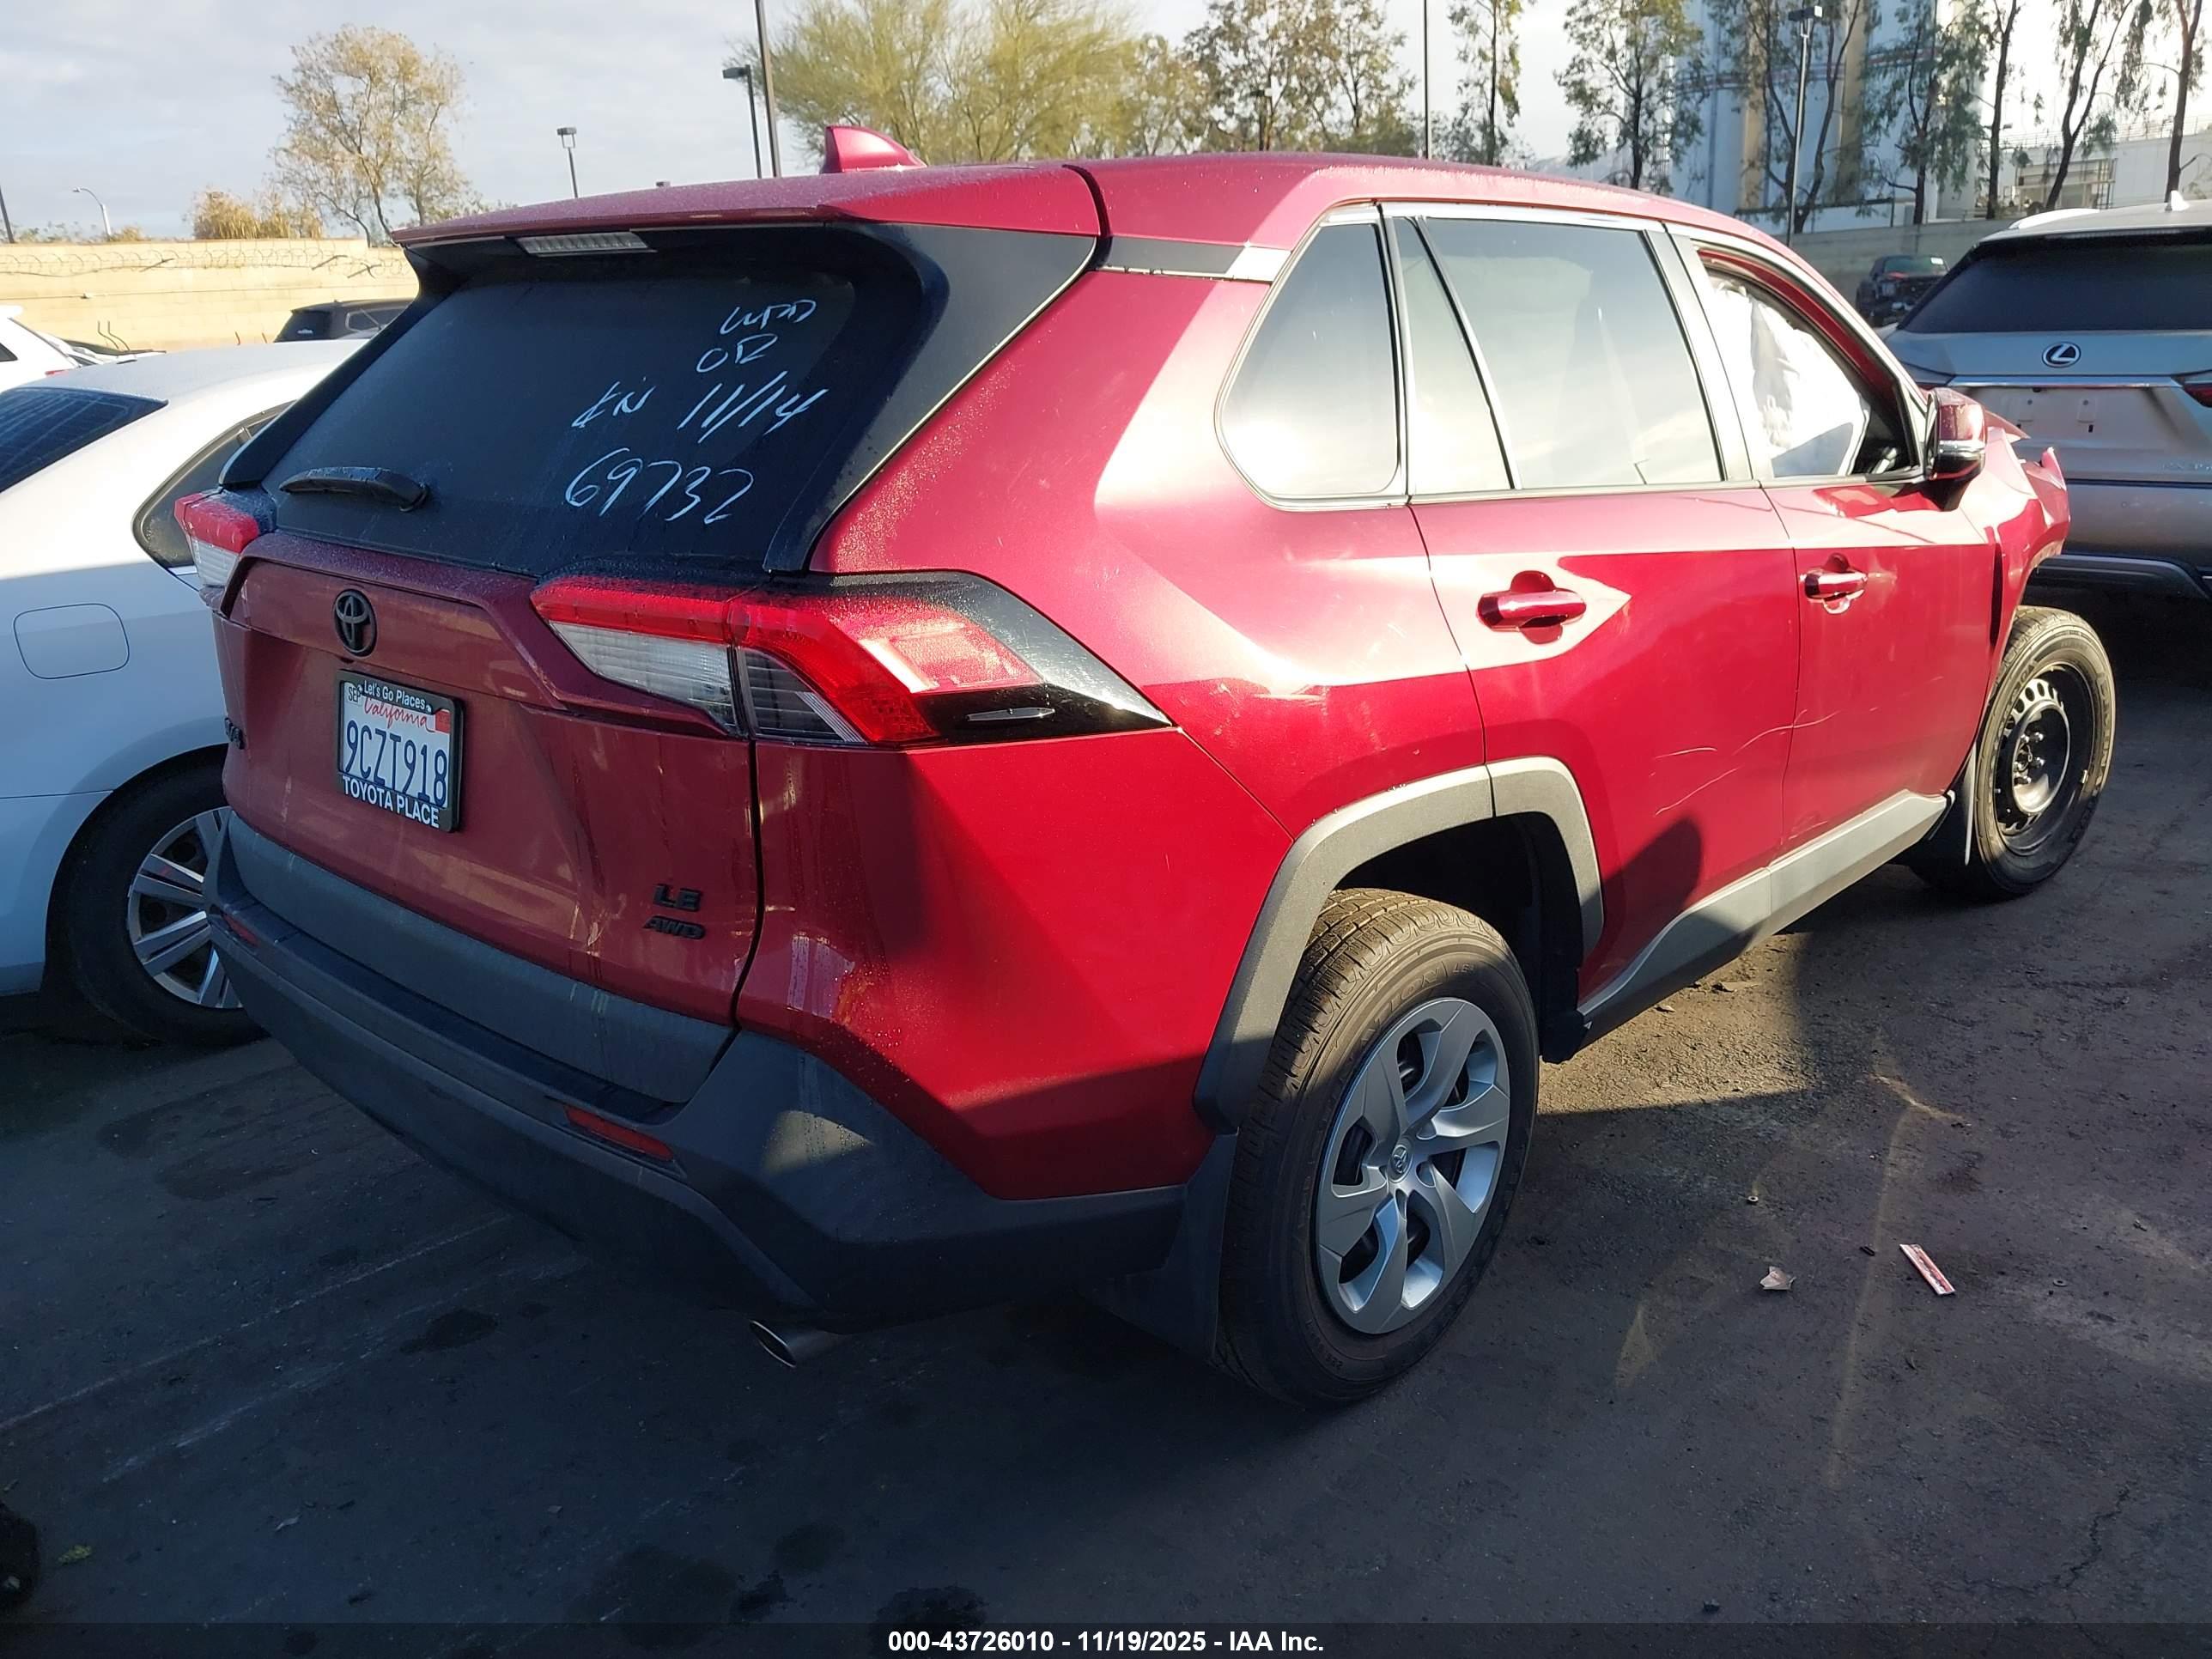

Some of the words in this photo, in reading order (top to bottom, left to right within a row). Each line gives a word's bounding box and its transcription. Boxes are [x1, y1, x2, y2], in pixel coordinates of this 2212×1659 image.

[677, 370, 830, 444] 11/14
[565, 447, 754, 525] 69732
[363, 680, 380, 697] Let's
[382, 686, 394, 702] Go
[396, 690, 426, 710] Places
[364, 697, 435, 732] California
[345, 720, 448, 807] 9CZT918
[343, 775, 393, 811] TOYOTA
[396, 793, 440, 829] PLACE
[653, 883, 703, 912] LE
[642, 915, 706, 940] AWD
